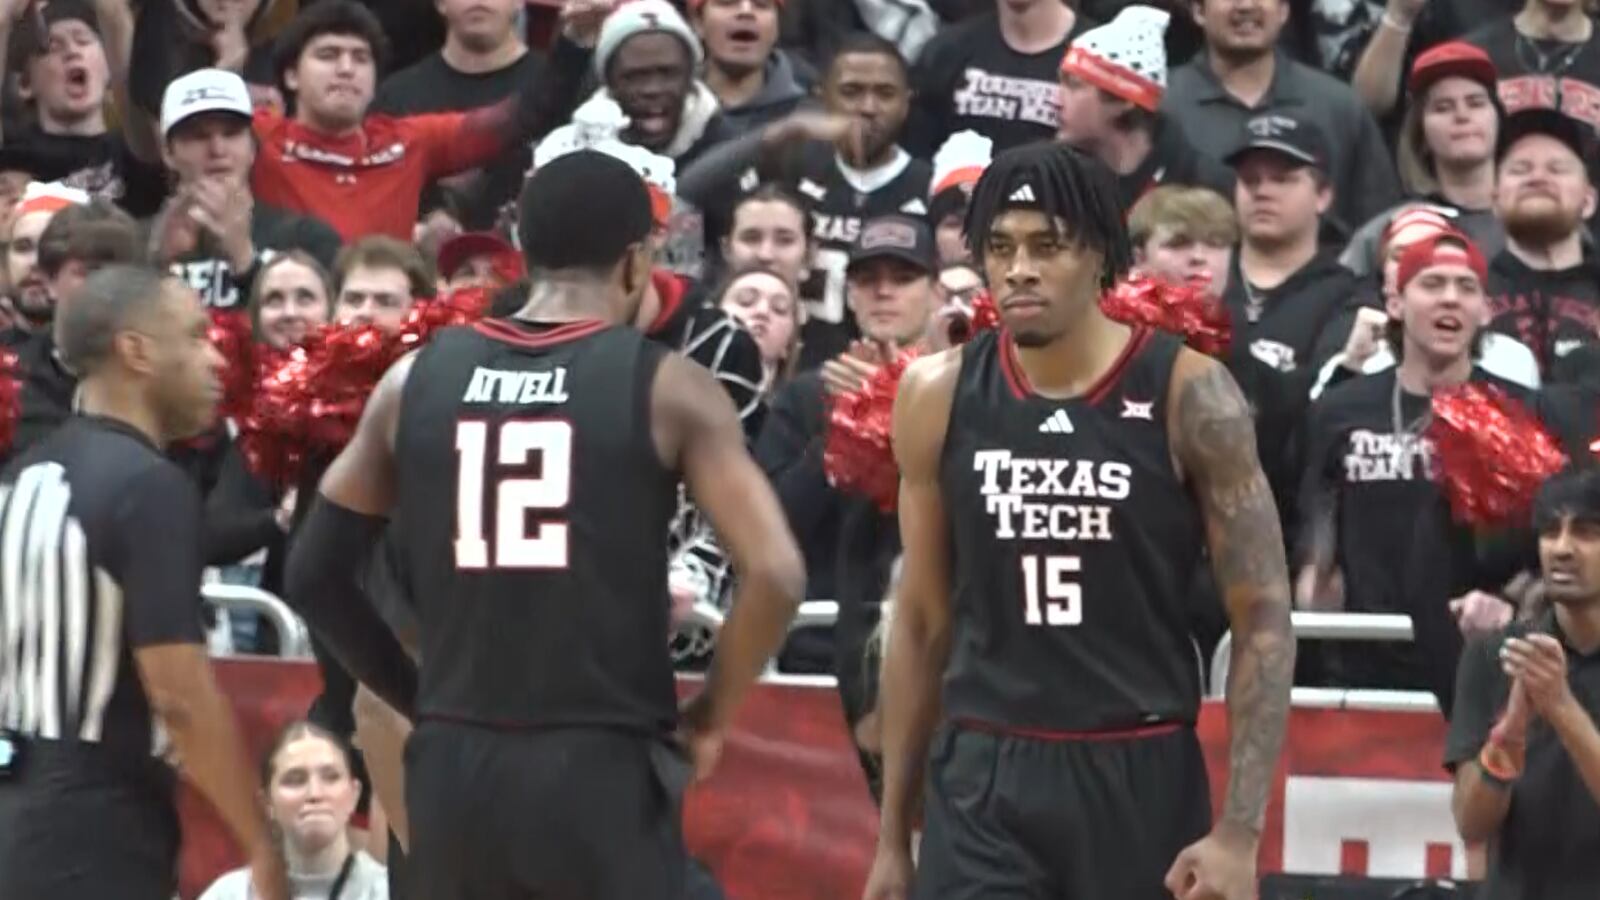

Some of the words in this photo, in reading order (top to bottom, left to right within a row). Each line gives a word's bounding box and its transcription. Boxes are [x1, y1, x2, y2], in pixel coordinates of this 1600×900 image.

[462, 366, 569, 404] ATWELL
[452, 418, 573, 570] 12
[973, 449, 1132, 500] TEXAS
[986, 493, 1113, 541] TECH
[1021, 554, 1083, 626] 15
